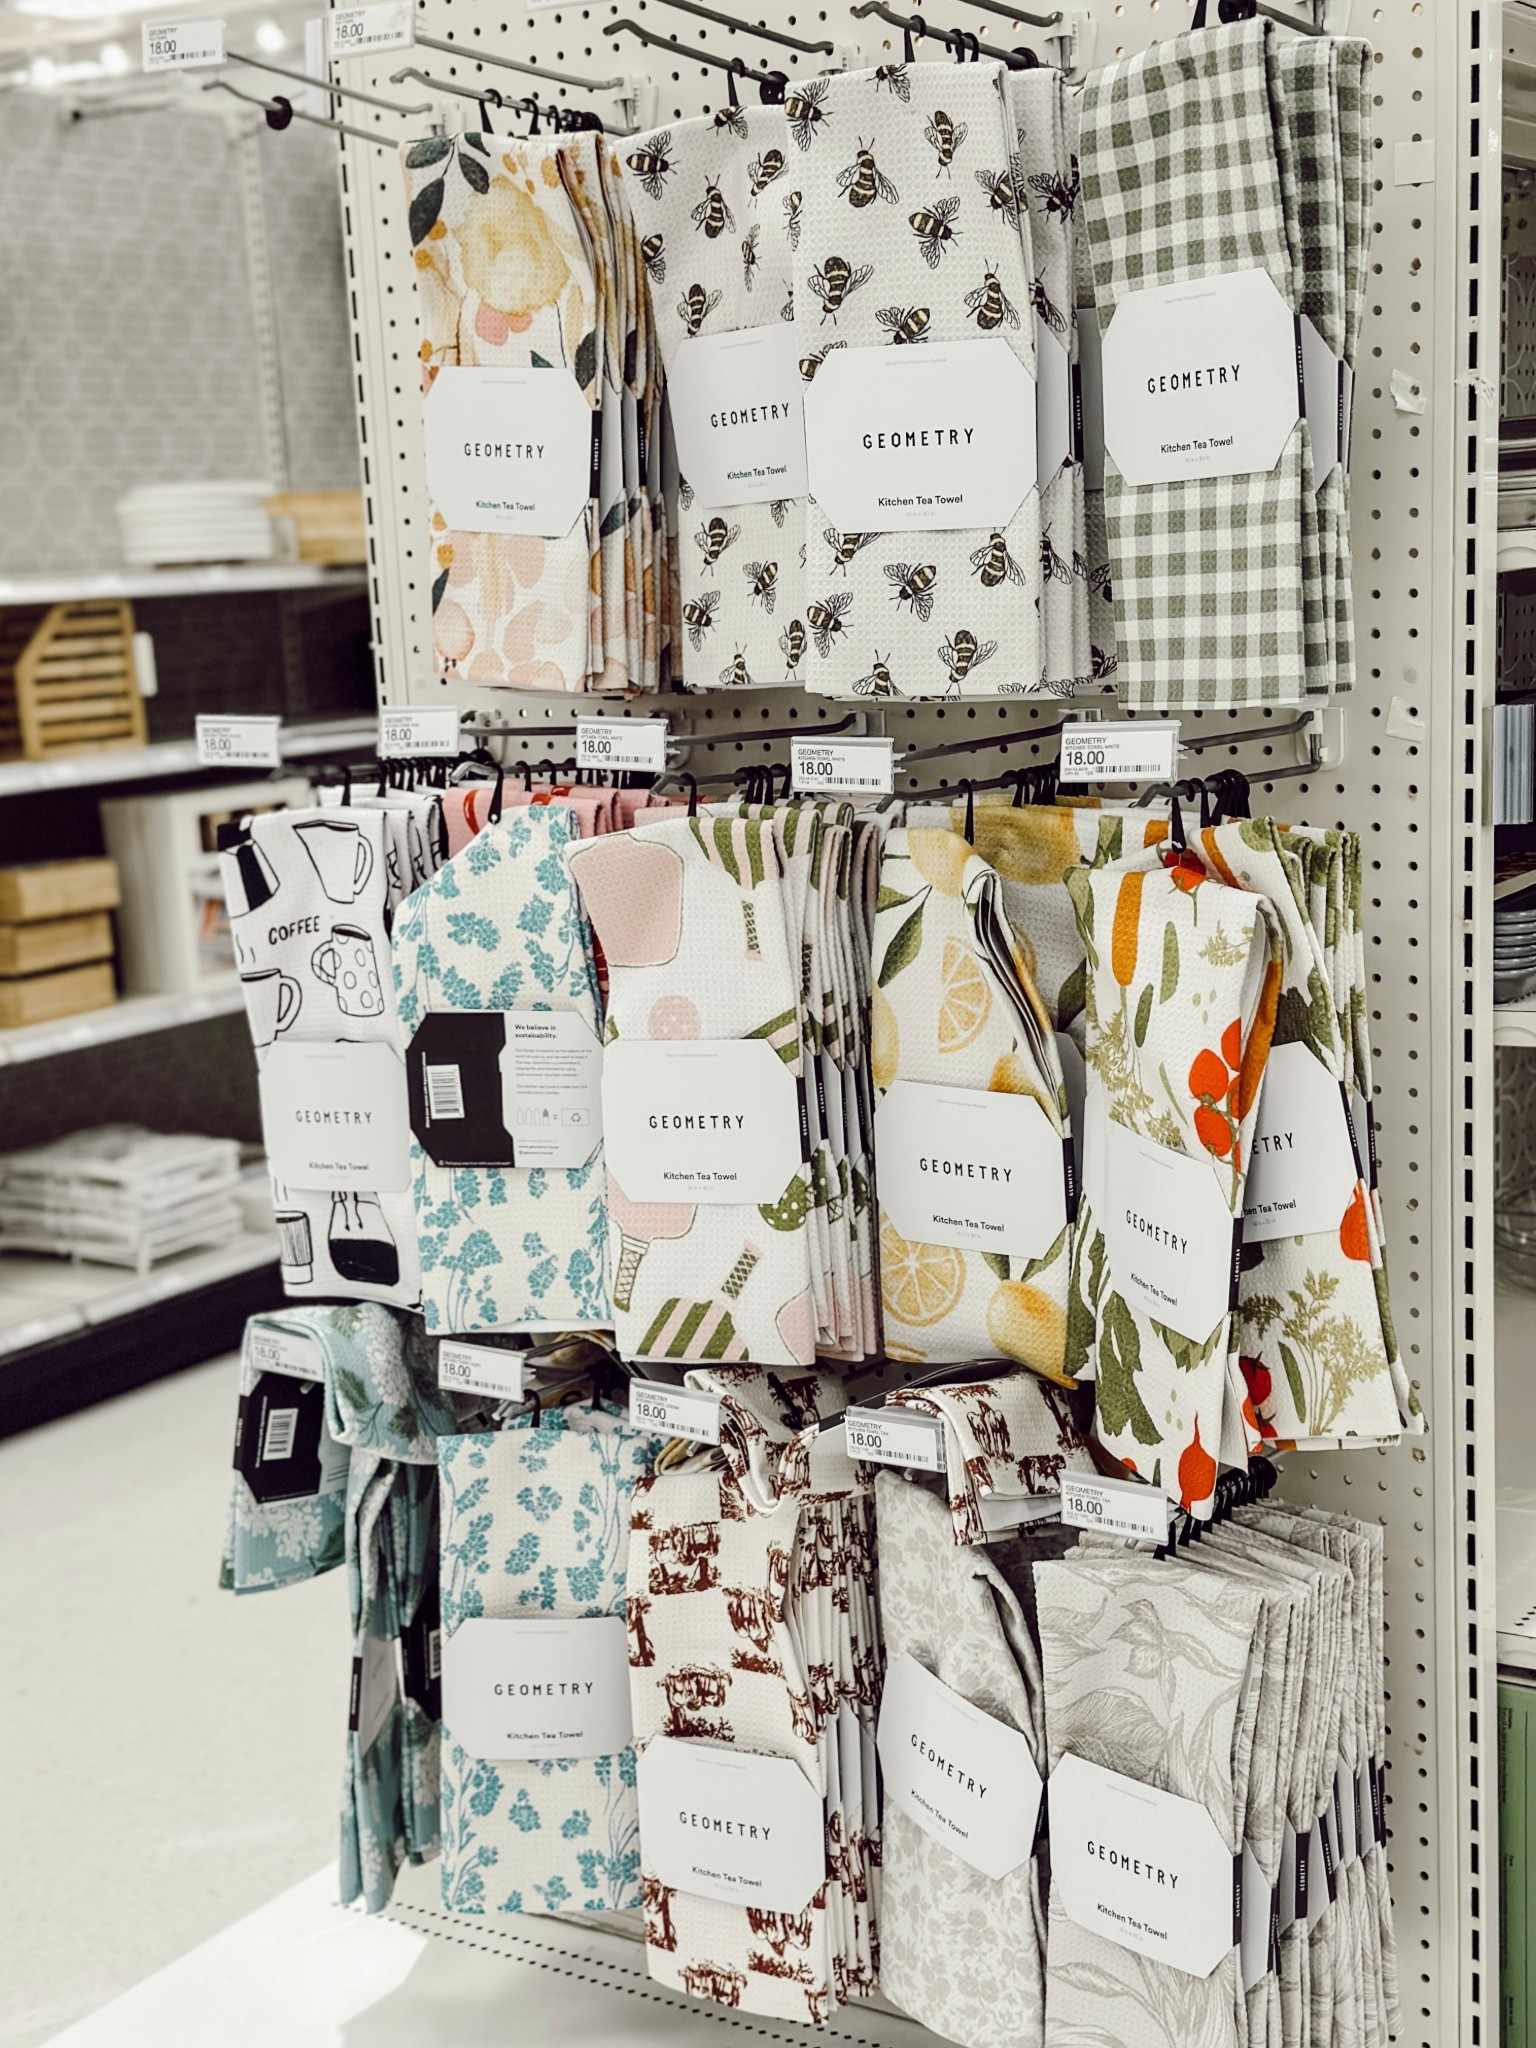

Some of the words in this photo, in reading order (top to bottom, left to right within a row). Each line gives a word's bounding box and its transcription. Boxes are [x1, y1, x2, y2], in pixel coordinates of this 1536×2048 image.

[337, 23, 363, 39] 18.00
[151, 40, 176, 55] 18.00
[1147, 364, 1240, 394] GEOMETRY
[710, 403, 790, 427] GEOMETRY
[863, 428, 974, 449] GEOMETRY
[1160, 443, 1191, 454] Kitchen
[1193, 441, 1207, 450] Tea
[1209, 436, 1234, 448] Towel
[464, 443, 545, 459] GEOMETRY
[727, 470, 752, 481] Kitchen
[753, 468, 765, 478] Tea
[767, 465, 787, 476] Towel
[475, 500, 501, 511] Kitchen
[502, 502, 514, 511] Tea
[515, 502, 536, 511] Towel
[878, 497, 914, 507] Kitchen
[916, 496, 933, 505] Tea
[935, 494, 963, 505] Towel
[385, 728, 411, 741] 18.00
[1065, 737, 1107, 745] GEOMETRY
[204, 738, 231, 751] 18.00
[582, 740, 611, 754] 18.00
[1066, 750, 1105, 765] 18.00
[800, 761, 833, 776] 18.00
[268, 915, 320, 945] COFFEE
[295, 1110, 372, 1125] GEOMETRY
[649, 1115, 744, 1129] GEOMETRY
[1252, 1133, 1292, 1155] ETRY
[309, 1162, 334, 1171] Kitchen
[335, 1163, 347, 1171] Tea
[348, 1163, 370, 1171] Towel
[919, 1157, 1012, 1183] GEOMETRY
[663, 1171, 695, 1181] Kitchen
[696, 1172, 711, 1181] Tea
[713, 1172, 737, 1181] Towel
[1258, 1205, 1272, 1214] Tea
[1273, 1199, 1297, 1211] Towel
[932, 1214, 963, 1227] Kitchen
[965, 1219, 979, 1229] Tea
[980, 1221, 1005, 1232] Towel
[1126, 1209, 1188, 1254] GEOMETRY
[1130, 1272, 1149, 1291] Kitchen
[1150, 1285, 1160, 1296] Tea
[1160, 1289, 1178, 1307] Towel
[255, 1346, 280, 1360] 18.00
[443, 1351, 472, 1361] GEOMETRY
[444, 1362, 471, 1378] 18.00
[636, 1391, 668, 1402] GEOMETRY
[637, 1403, 666, 1420] 18.00
[848, 1420, 882, 1430] GEOMETRY
[850, 1431, 882, 1448] 18.00
[1066, 1484, 1103, 1496] GEOMETRY
[1068, 1497, 1103, 1515] 18.00
[494, 1682, 593, 1696] GEOMETRY
[507, 1732, 539, 1740] Kitchen
[558, 1731, 584, 1739] Towel
[911, 1733, 987, 1799] GEOMETRY
[910, 1788, 934, 1814] Kitchen
[935, 1808, 946, 1824] Tea
[947, 1819, 969, 1839] Towel
[680, 1811, 771, 1841] GEOMETRY
[1087, 1840, 1179, 1890] GEOMETRY
[692, 1866, 721, 1879] Kitchen
[723, 1872, 736, 1883] Tea
[738, 1875, 762, 1888] Towel
[1097, 1902, 1126, 1923] Kitchen
[1127, 1915, 1142, 1930] Tea
[1142, 1920, 1168, 1940] Towel
